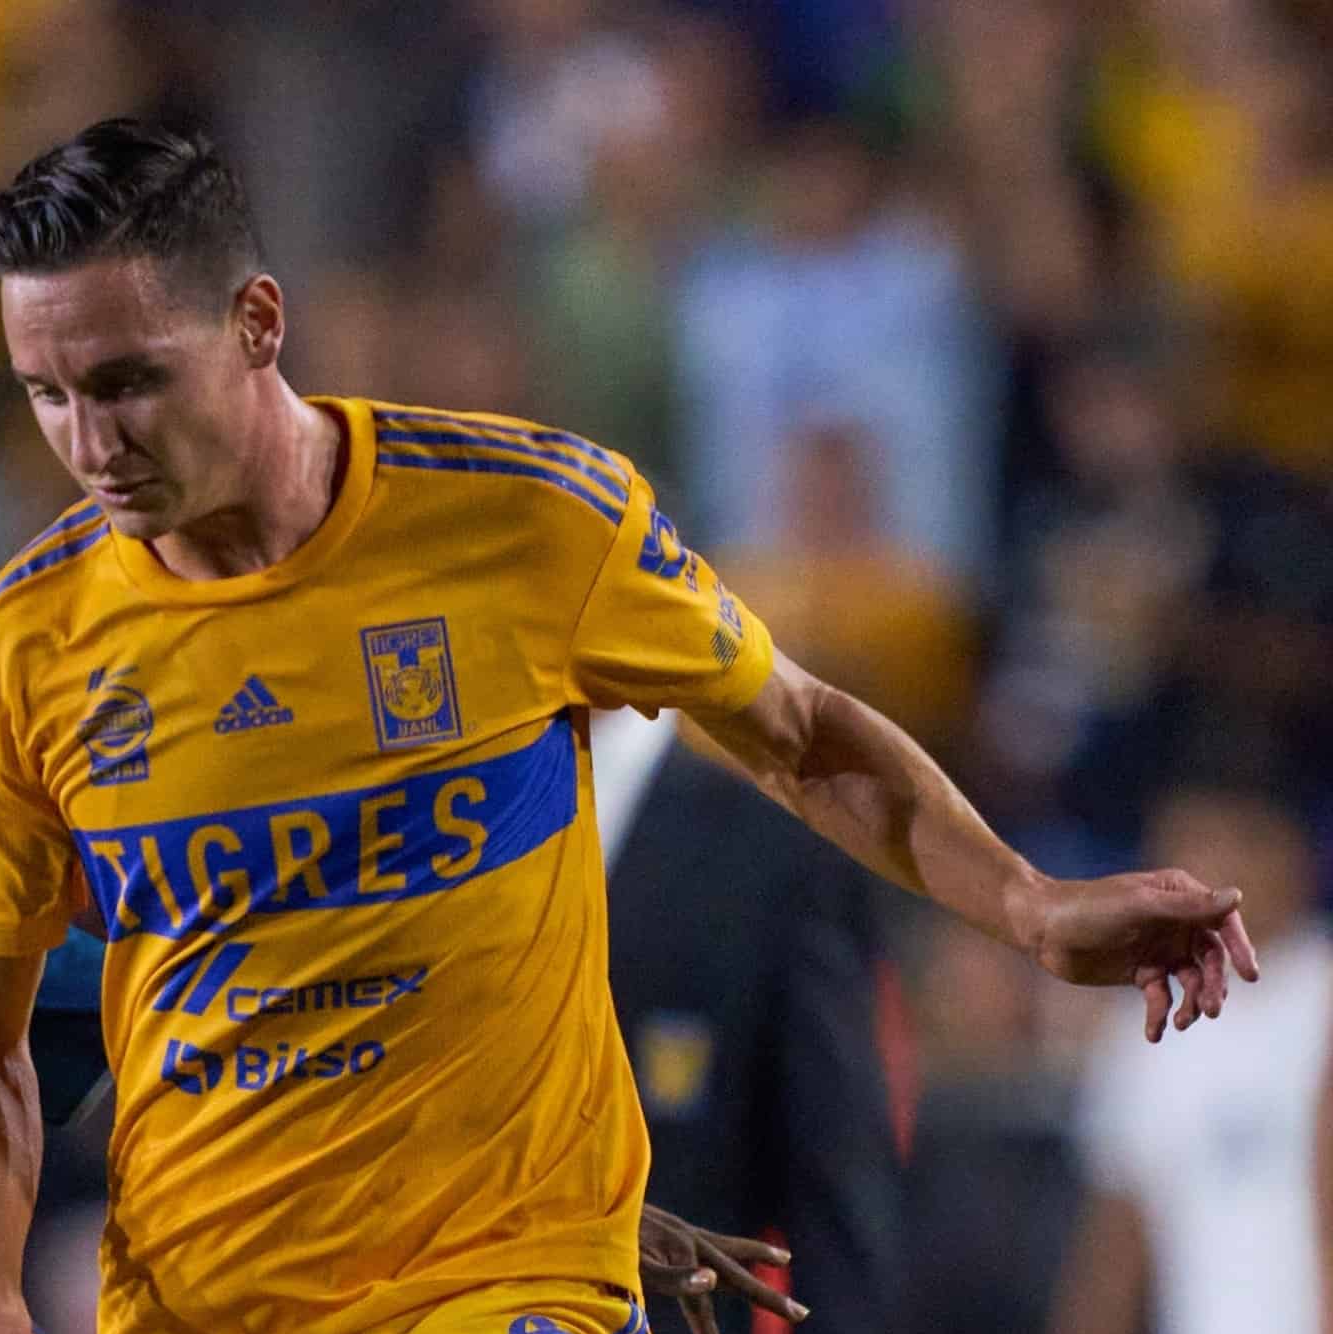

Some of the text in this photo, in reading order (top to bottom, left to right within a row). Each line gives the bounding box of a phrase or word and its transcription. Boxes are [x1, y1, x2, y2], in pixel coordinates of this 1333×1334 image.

[213, 707, 294, 734] adidas
[88, 776, 490, 929] TIGRES
[235, 1038, 386, 1092] Bitso
